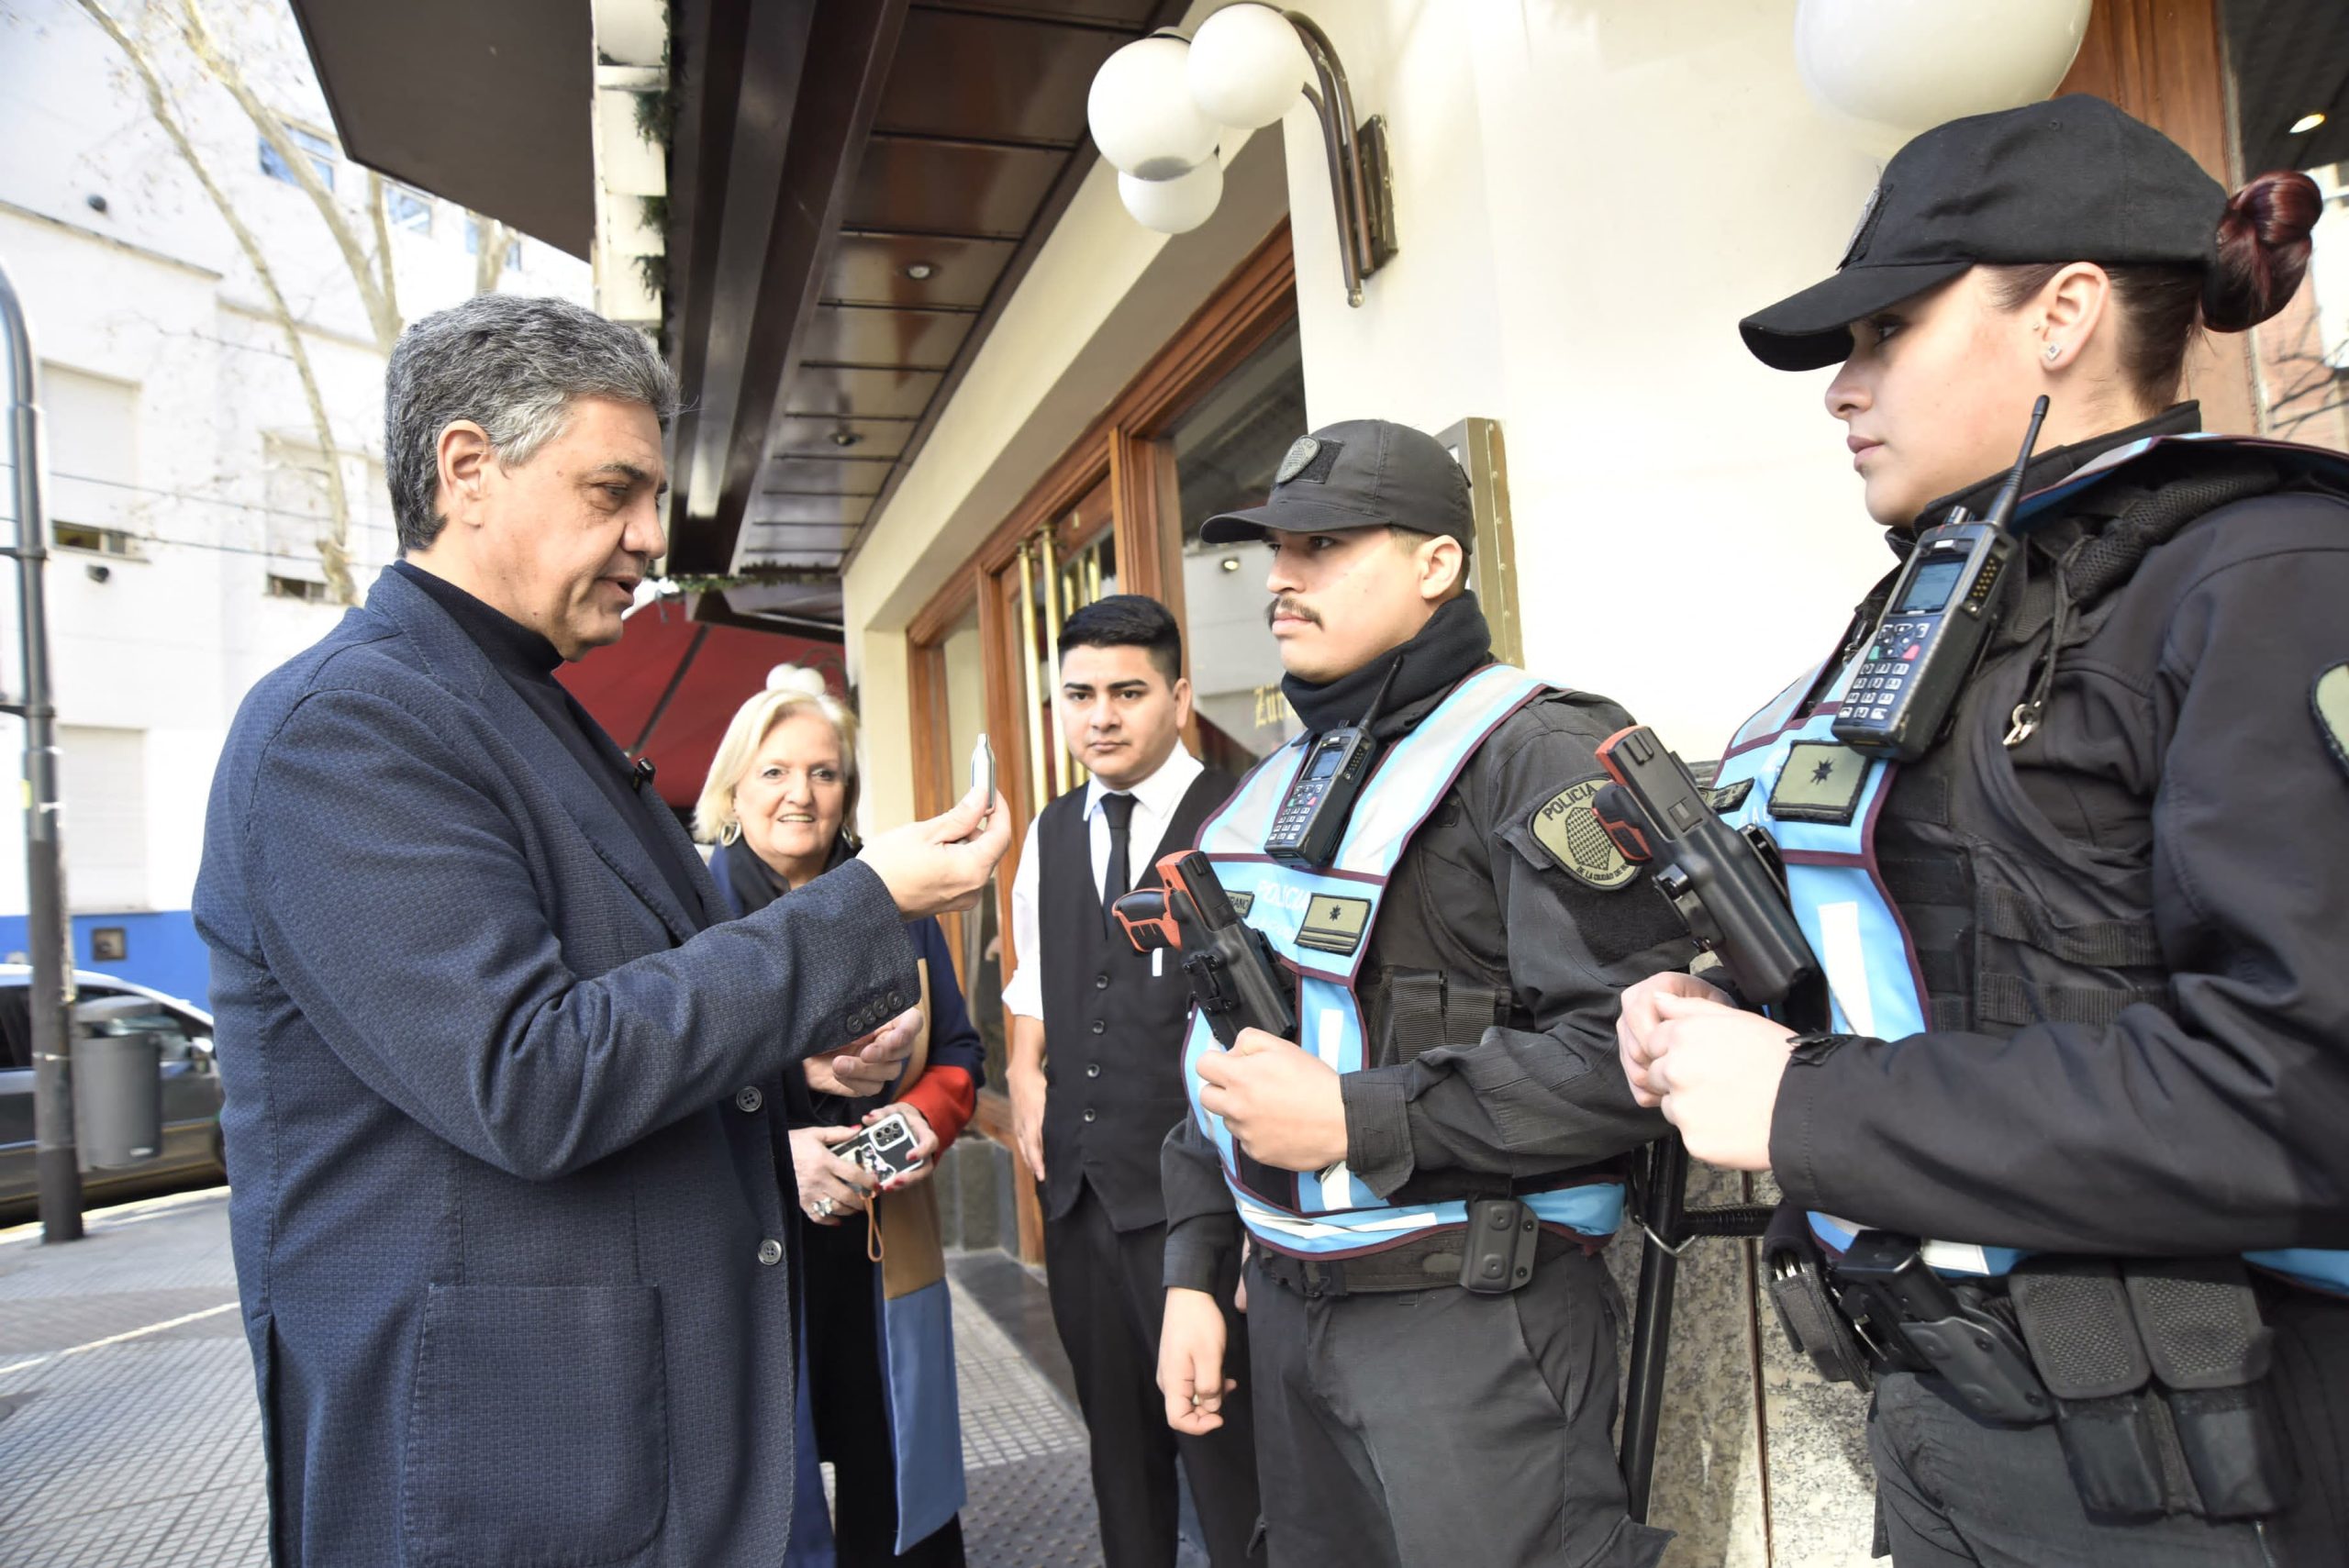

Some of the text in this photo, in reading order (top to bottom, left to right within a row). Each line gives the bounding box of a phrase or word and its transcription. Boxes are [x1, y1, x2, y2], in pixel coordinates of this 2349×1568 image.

[1542, 783, 1598, 821] POLICIA
[1576, 866, 1586, 874] DE
[1586, 871, 1593, 879] LA
